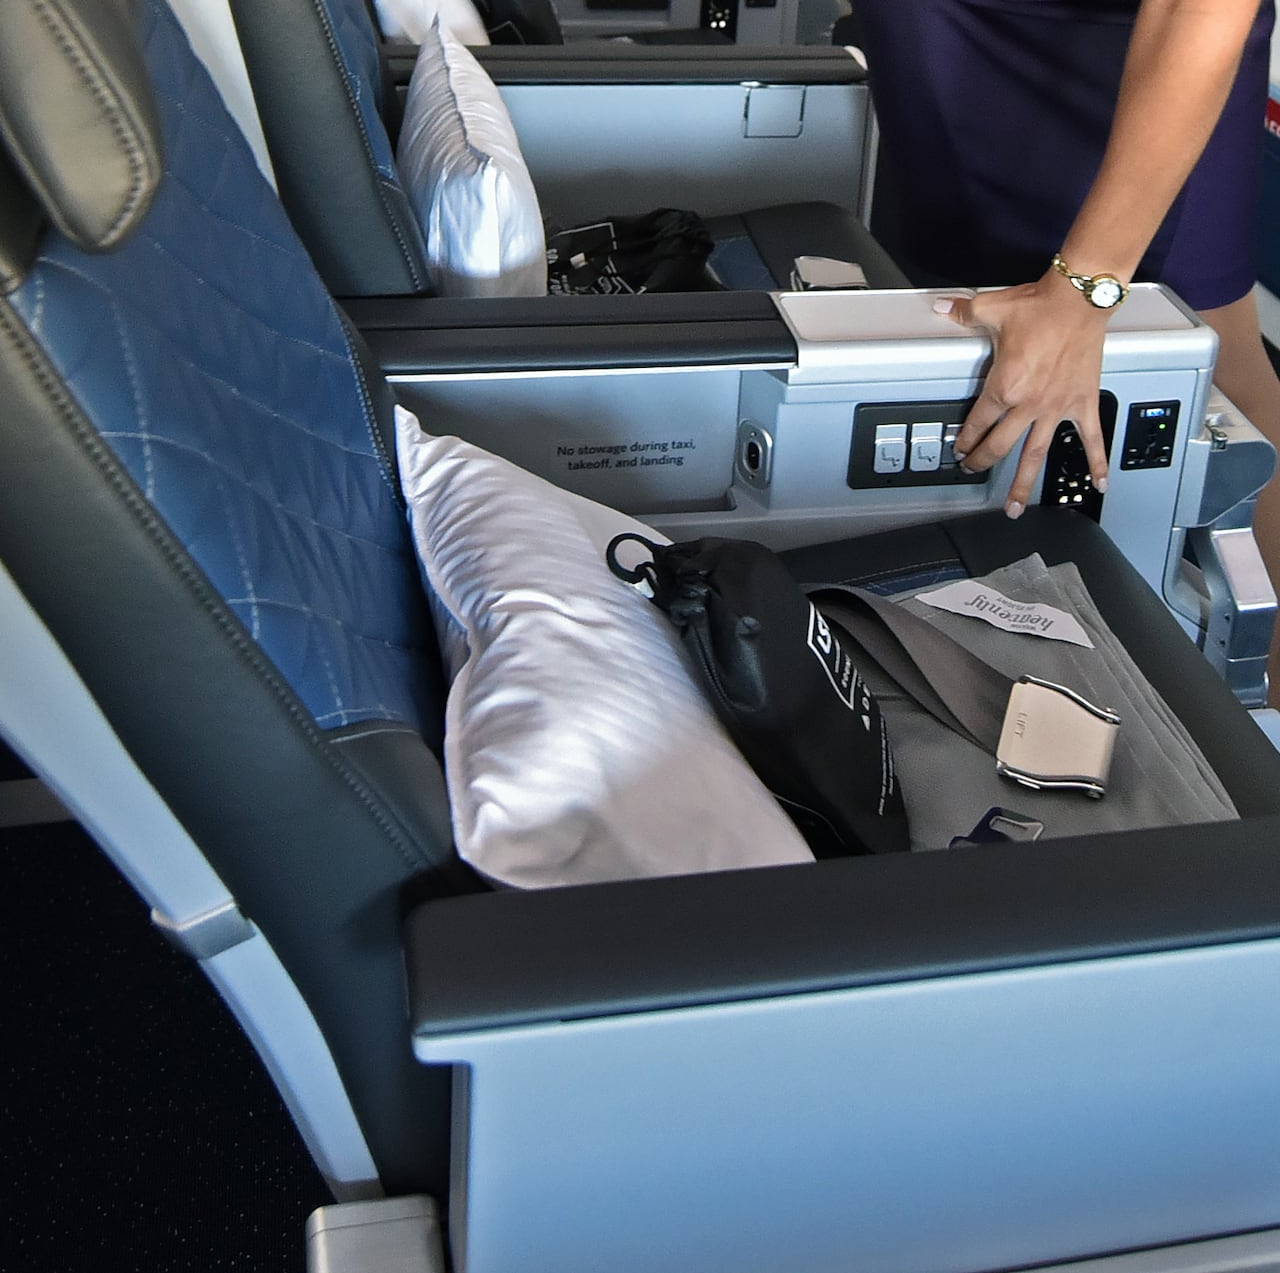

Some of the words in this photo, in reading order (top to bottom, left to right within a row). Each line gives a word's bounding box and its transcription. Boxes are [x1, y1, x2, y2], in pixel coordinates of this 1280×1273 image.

[557, 446, 575, 457] No
[577, 444, 628, 456] stowage
[629, 441, 669, 453] during
[671, 438, 696, 450] taxi,
[568, 458, 613, 471] takeoff,
[615, 456, 638, 468] and
[640, 455, 685, 467] landing
